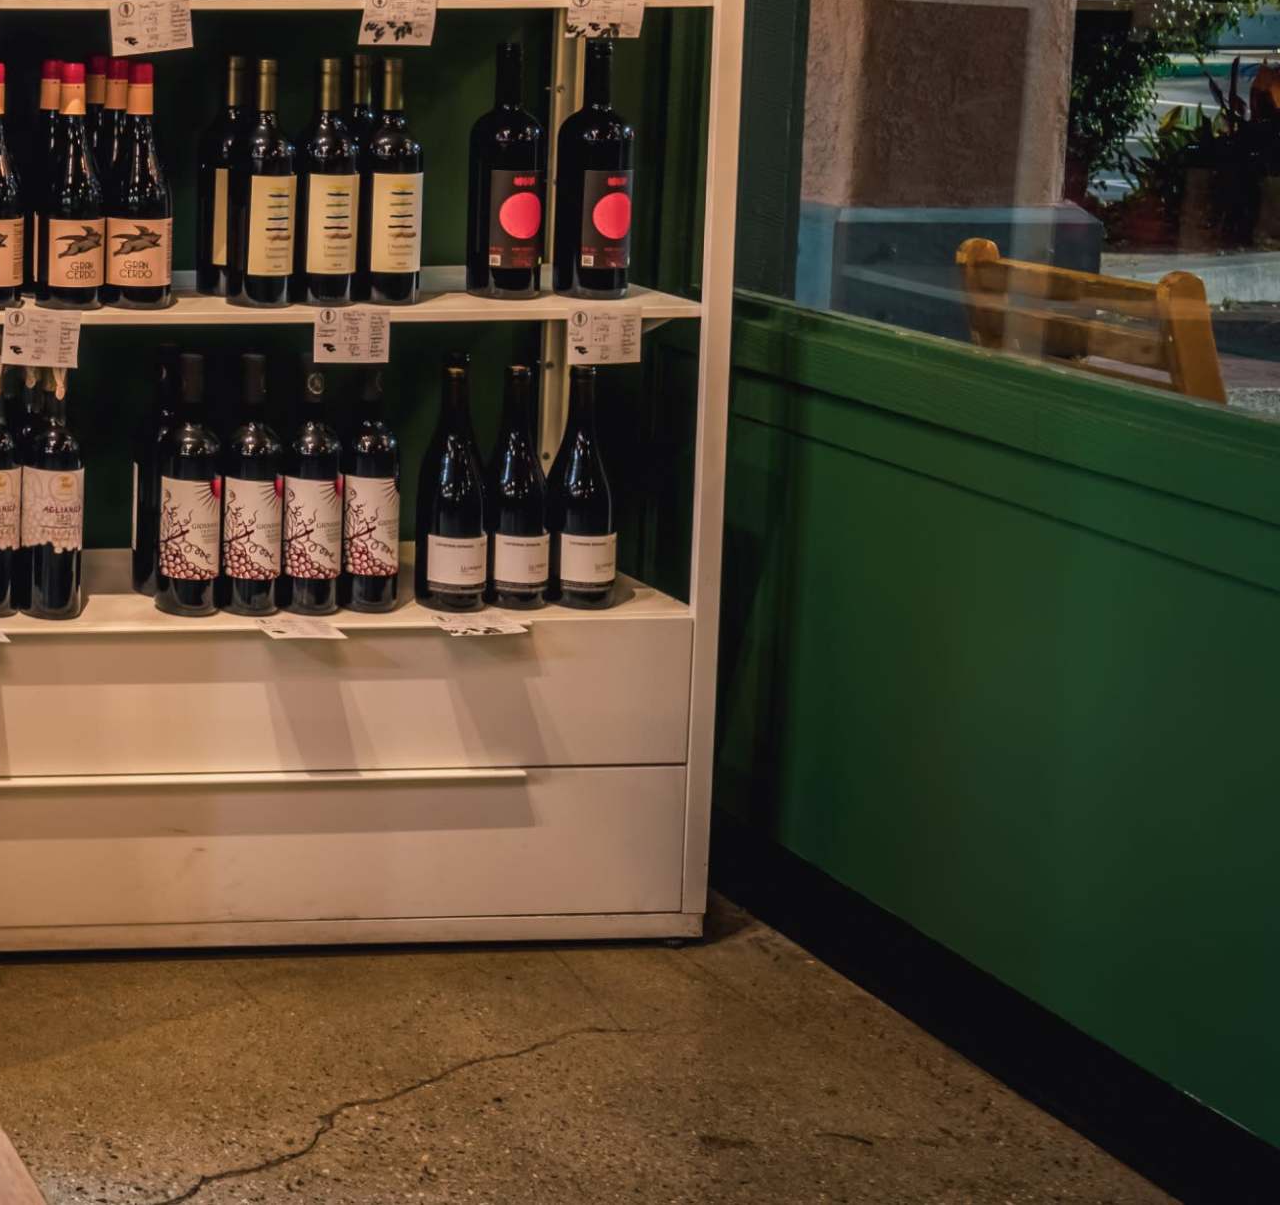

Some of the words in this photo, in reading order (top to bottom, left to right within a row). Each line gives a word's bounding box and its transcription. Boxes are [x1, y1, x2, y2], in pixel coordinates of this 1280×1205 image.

[71, 261, 94, 270] GRAN
[123, 260, 149, 269] GRAN
[65, 270, 96, 280] CERDO
[119, 269, 153, 279] CERDO
